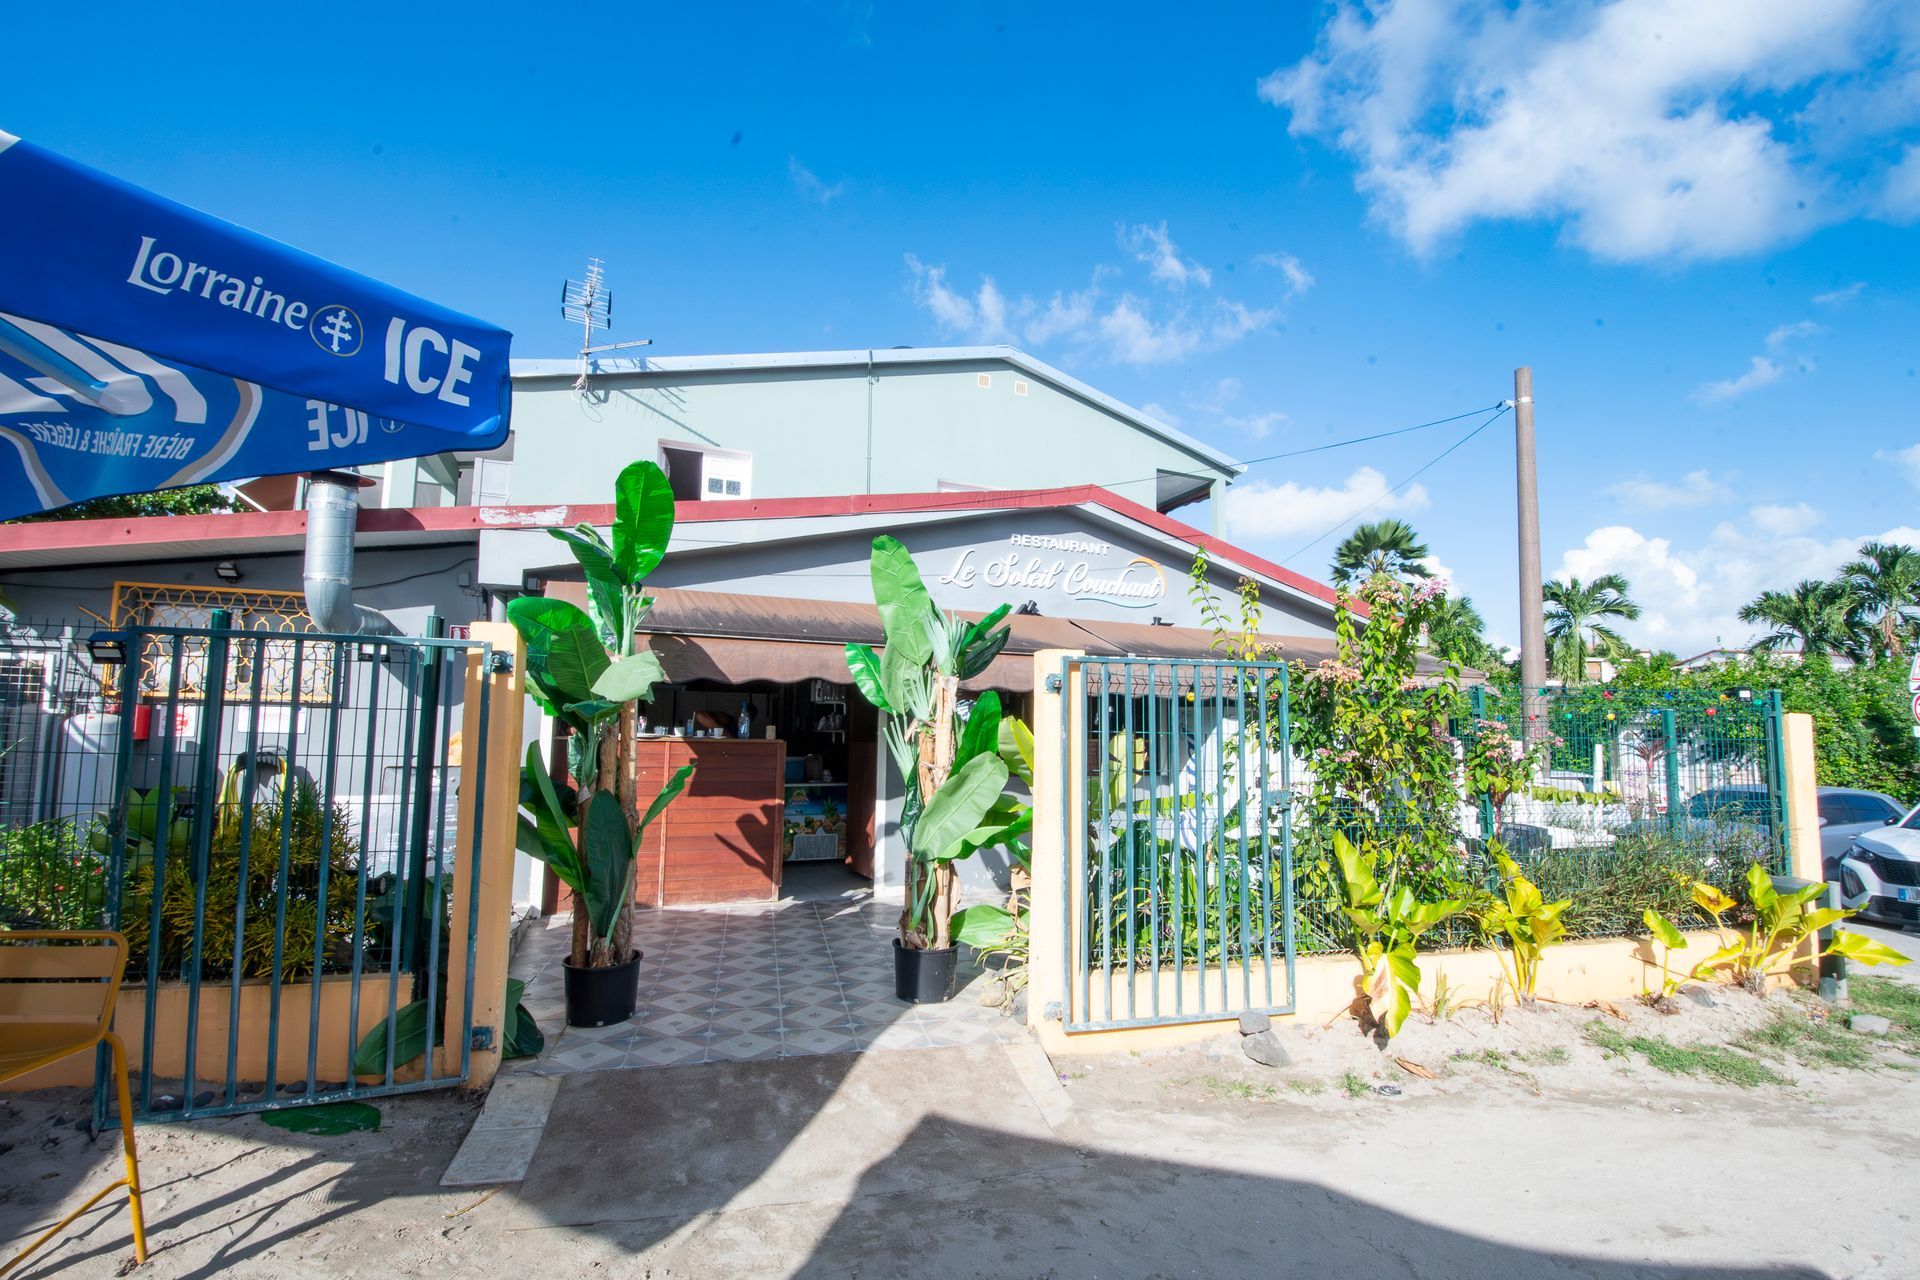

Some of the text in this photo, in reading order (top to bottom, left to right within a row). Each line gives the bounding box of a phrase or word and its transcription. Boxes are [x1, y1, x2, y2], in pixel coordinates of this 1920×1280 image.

[126, 235, 481, 407] Lorraine ICE
[1010, 533, 1110, 556] RESTAURANT
[939, 548, 1161, 599] Le Soleil Couchant
